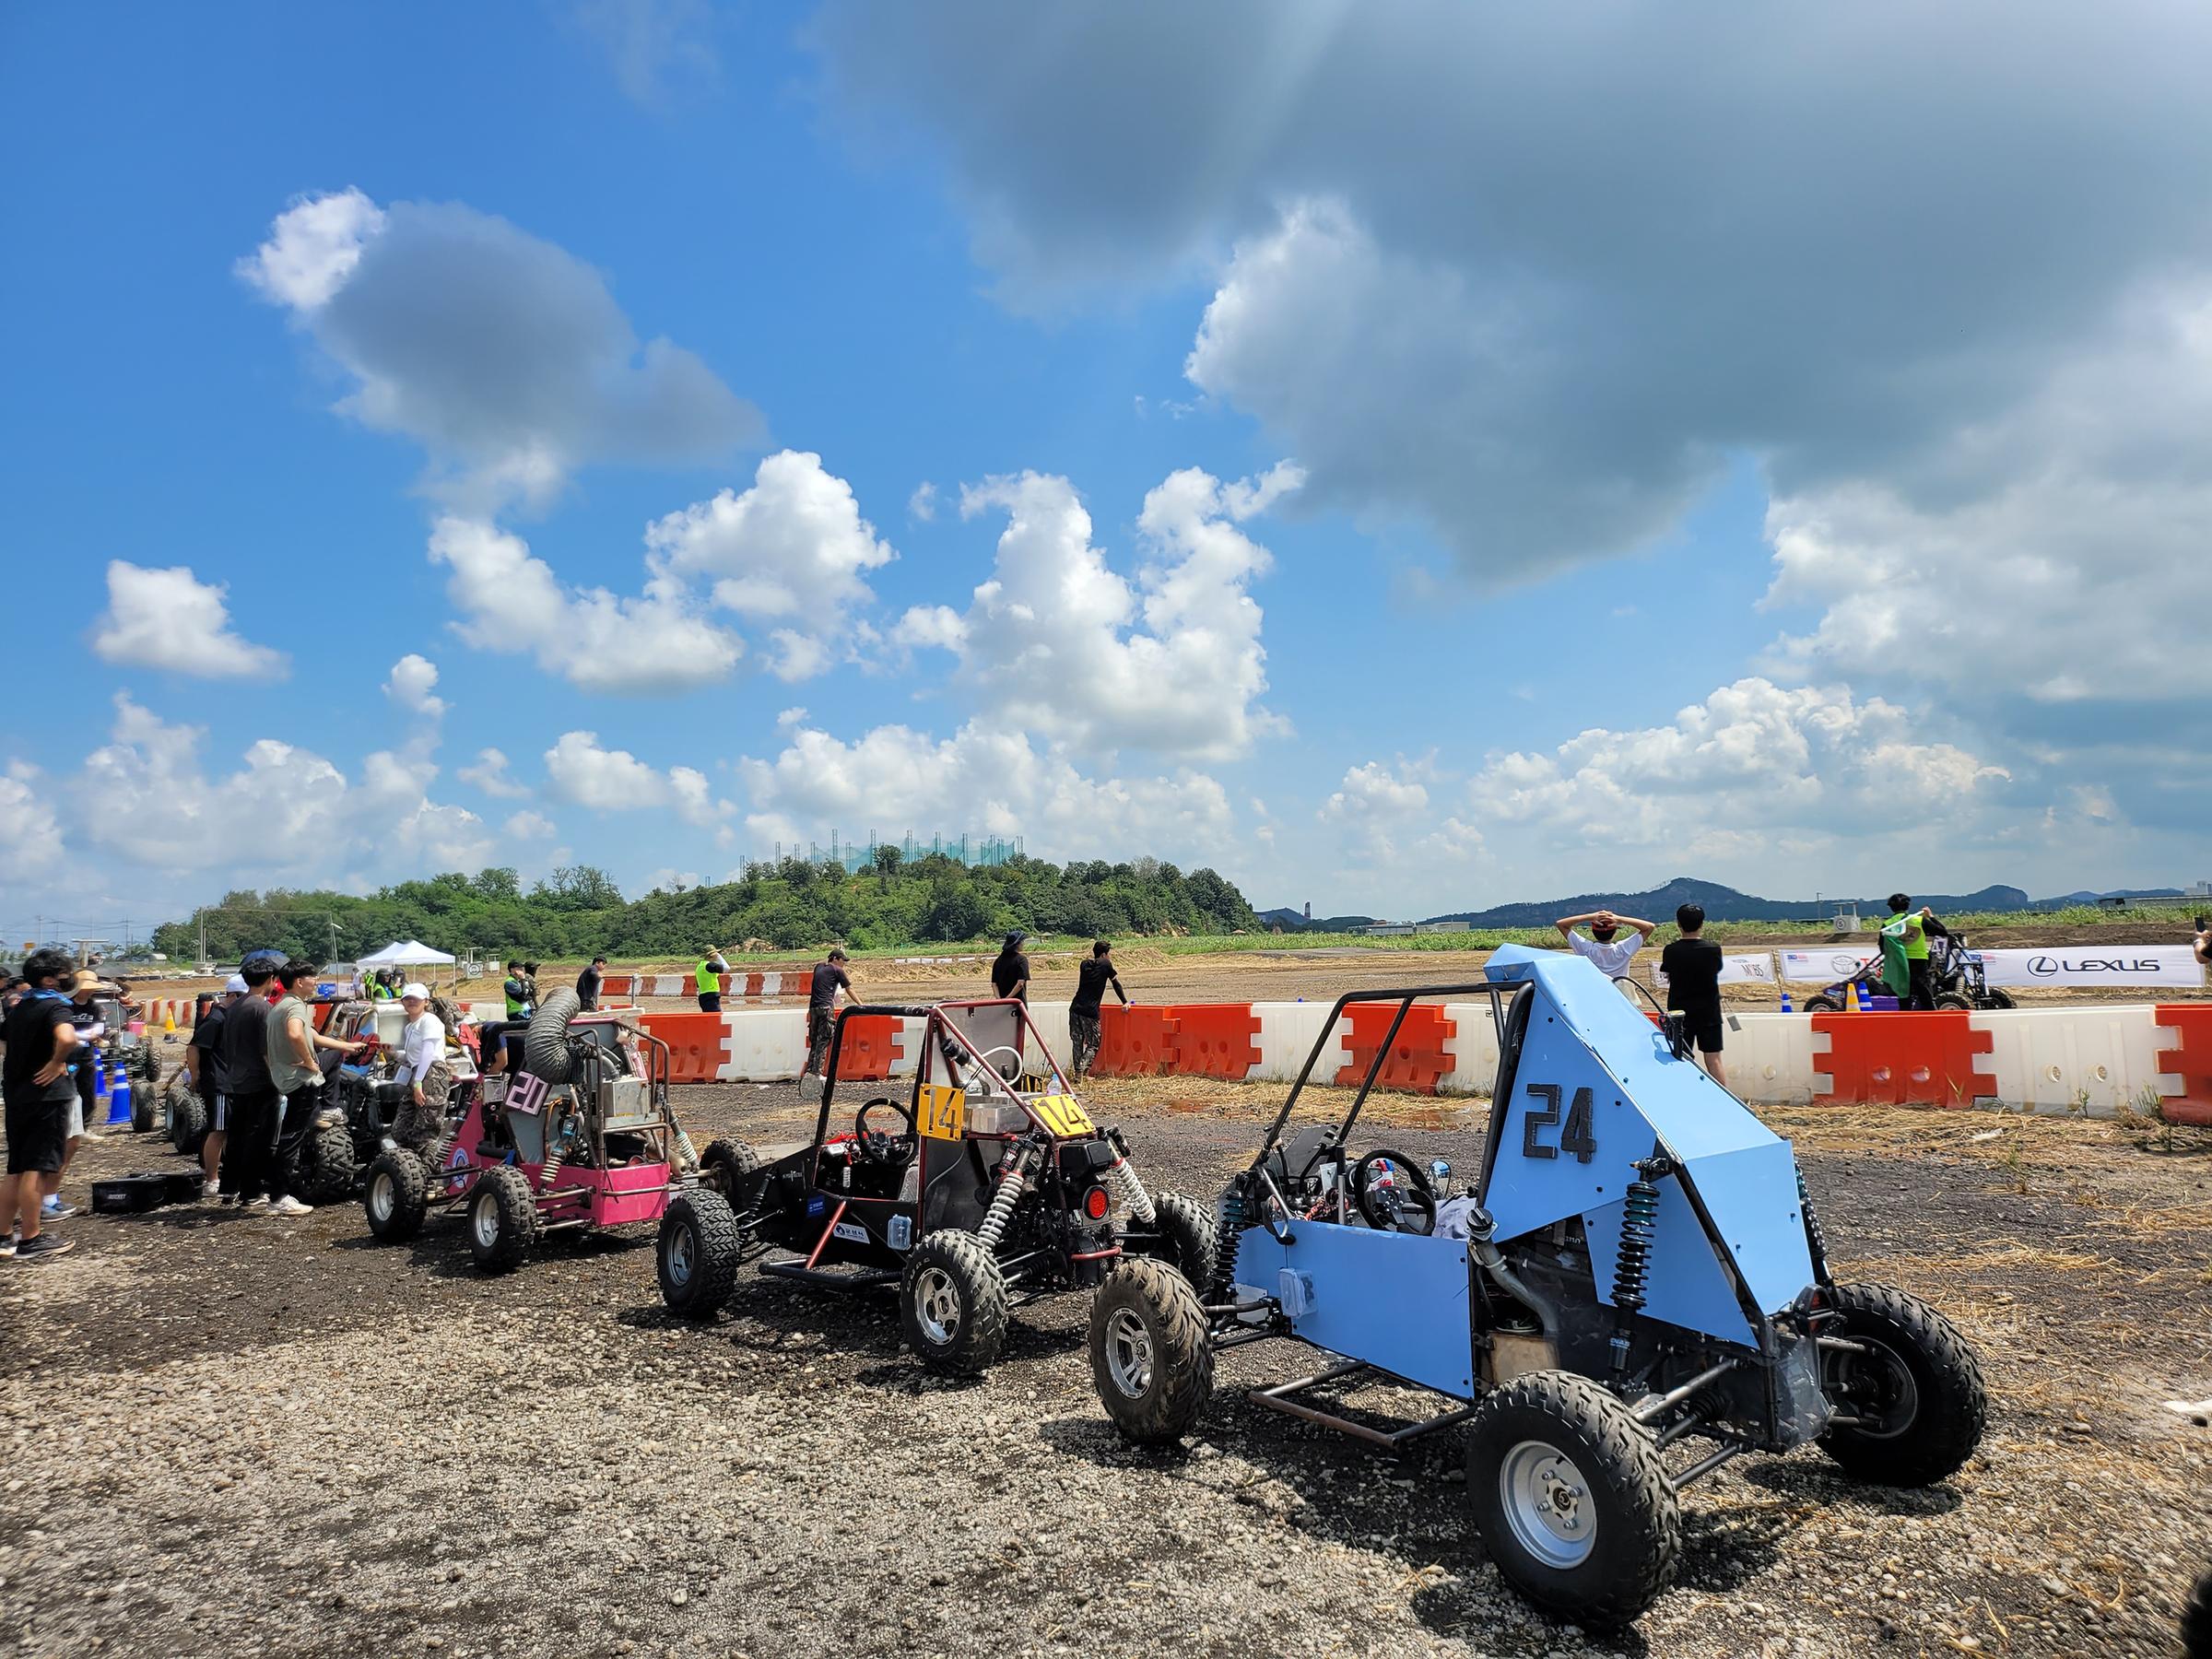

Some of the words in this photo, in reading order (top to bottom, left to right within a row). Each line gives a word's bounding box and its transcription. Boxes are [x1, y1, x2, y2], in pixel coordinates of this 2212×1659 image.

[2063, 959, 2160, 971] LEXUS
[505, 1070, 548, 1115] 20
[924, 1088, 959, 1138] 14
[1038, 1096, 1088, 1133] 14
[1524, 1083, 1597, 1164] 24
